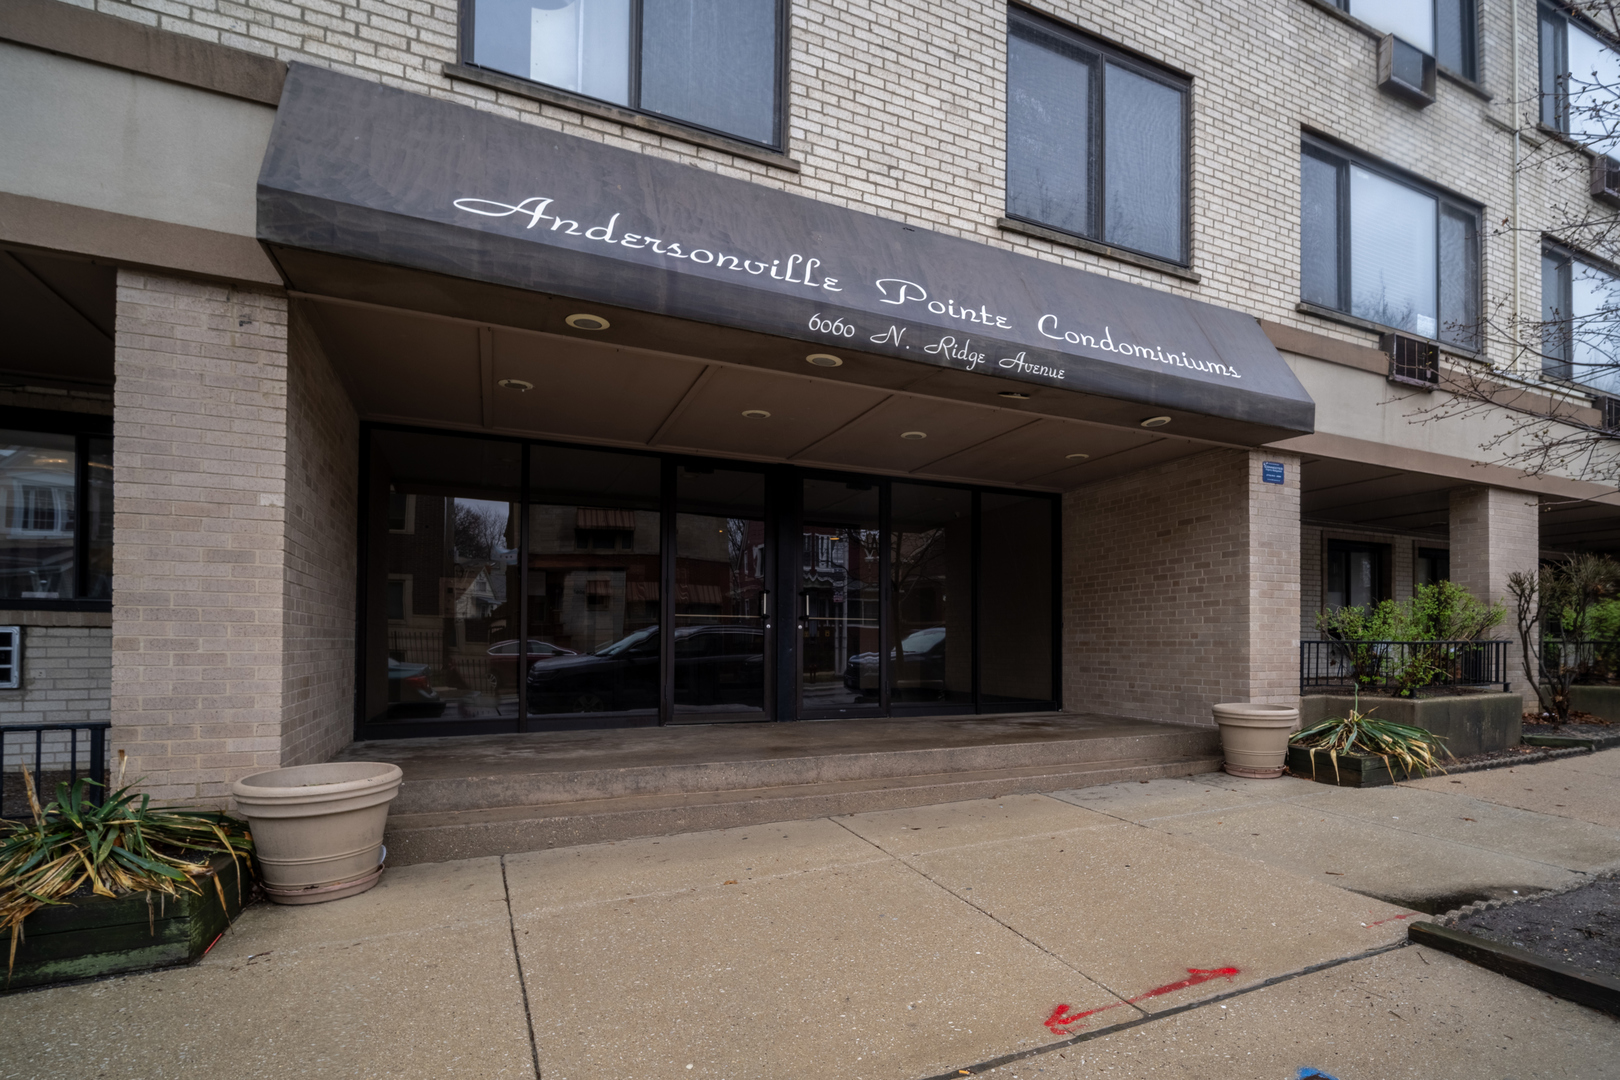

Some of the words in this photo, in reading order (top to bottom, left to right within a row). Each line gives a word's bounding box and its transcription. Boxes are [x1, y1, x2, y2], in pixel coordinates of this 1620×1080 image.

[452, 196, 843, 293] Andersonville
[874, 277, 1013, 330] Pointe
[1036, 313, 1242, 380] Condominiums
[807, 312, 856, 338] 6060
[869, 324, 911, 350] N.
[923, 335, 986, 371] Ridge
[998, 350, 1066, 380] Avenue
